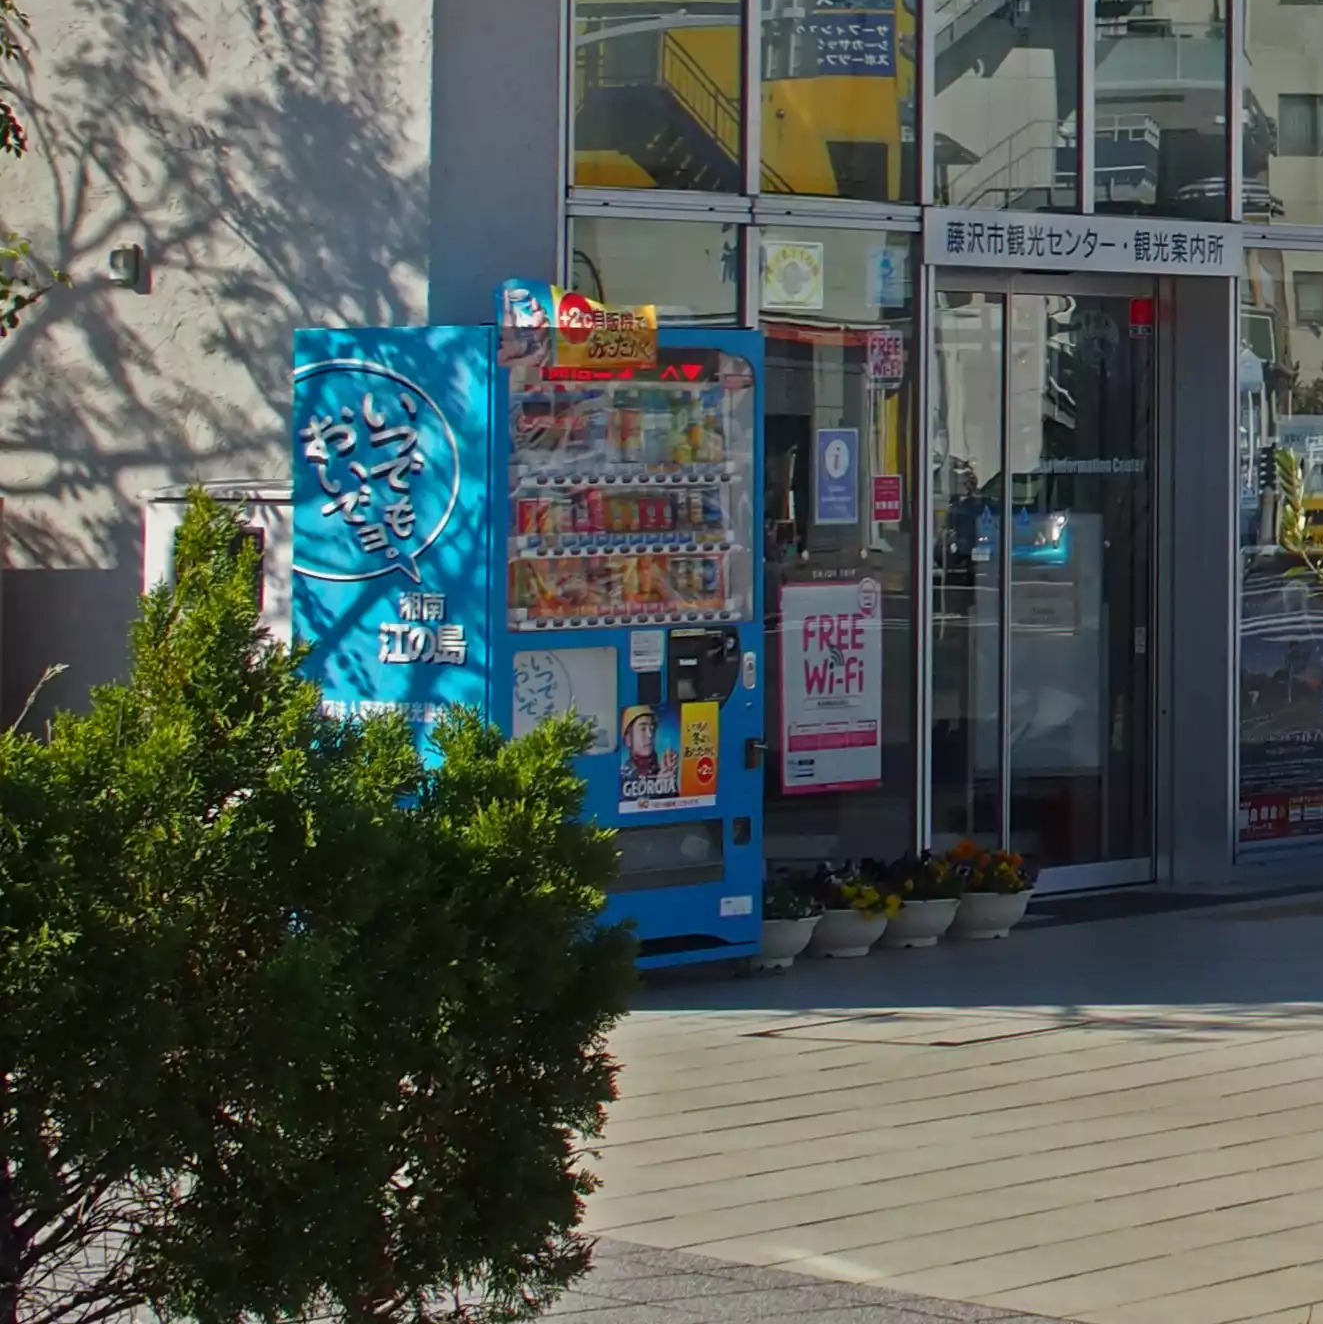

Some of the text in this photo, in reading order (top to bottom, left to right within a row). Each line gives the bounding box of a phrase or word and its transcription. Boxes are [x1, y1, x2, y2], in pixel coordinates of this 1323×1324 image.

[946, 222, 1224, 266] 藤沢市観光センター・観光案内所
[401, 592, 447, 622] 湘南
[378, 622, 468, 666] 江の島
[802, 612, 865, 653] FREE
[803, 656, 865, 696] Wi-Fi
[622, 778, 678, 798] GEORGIA
